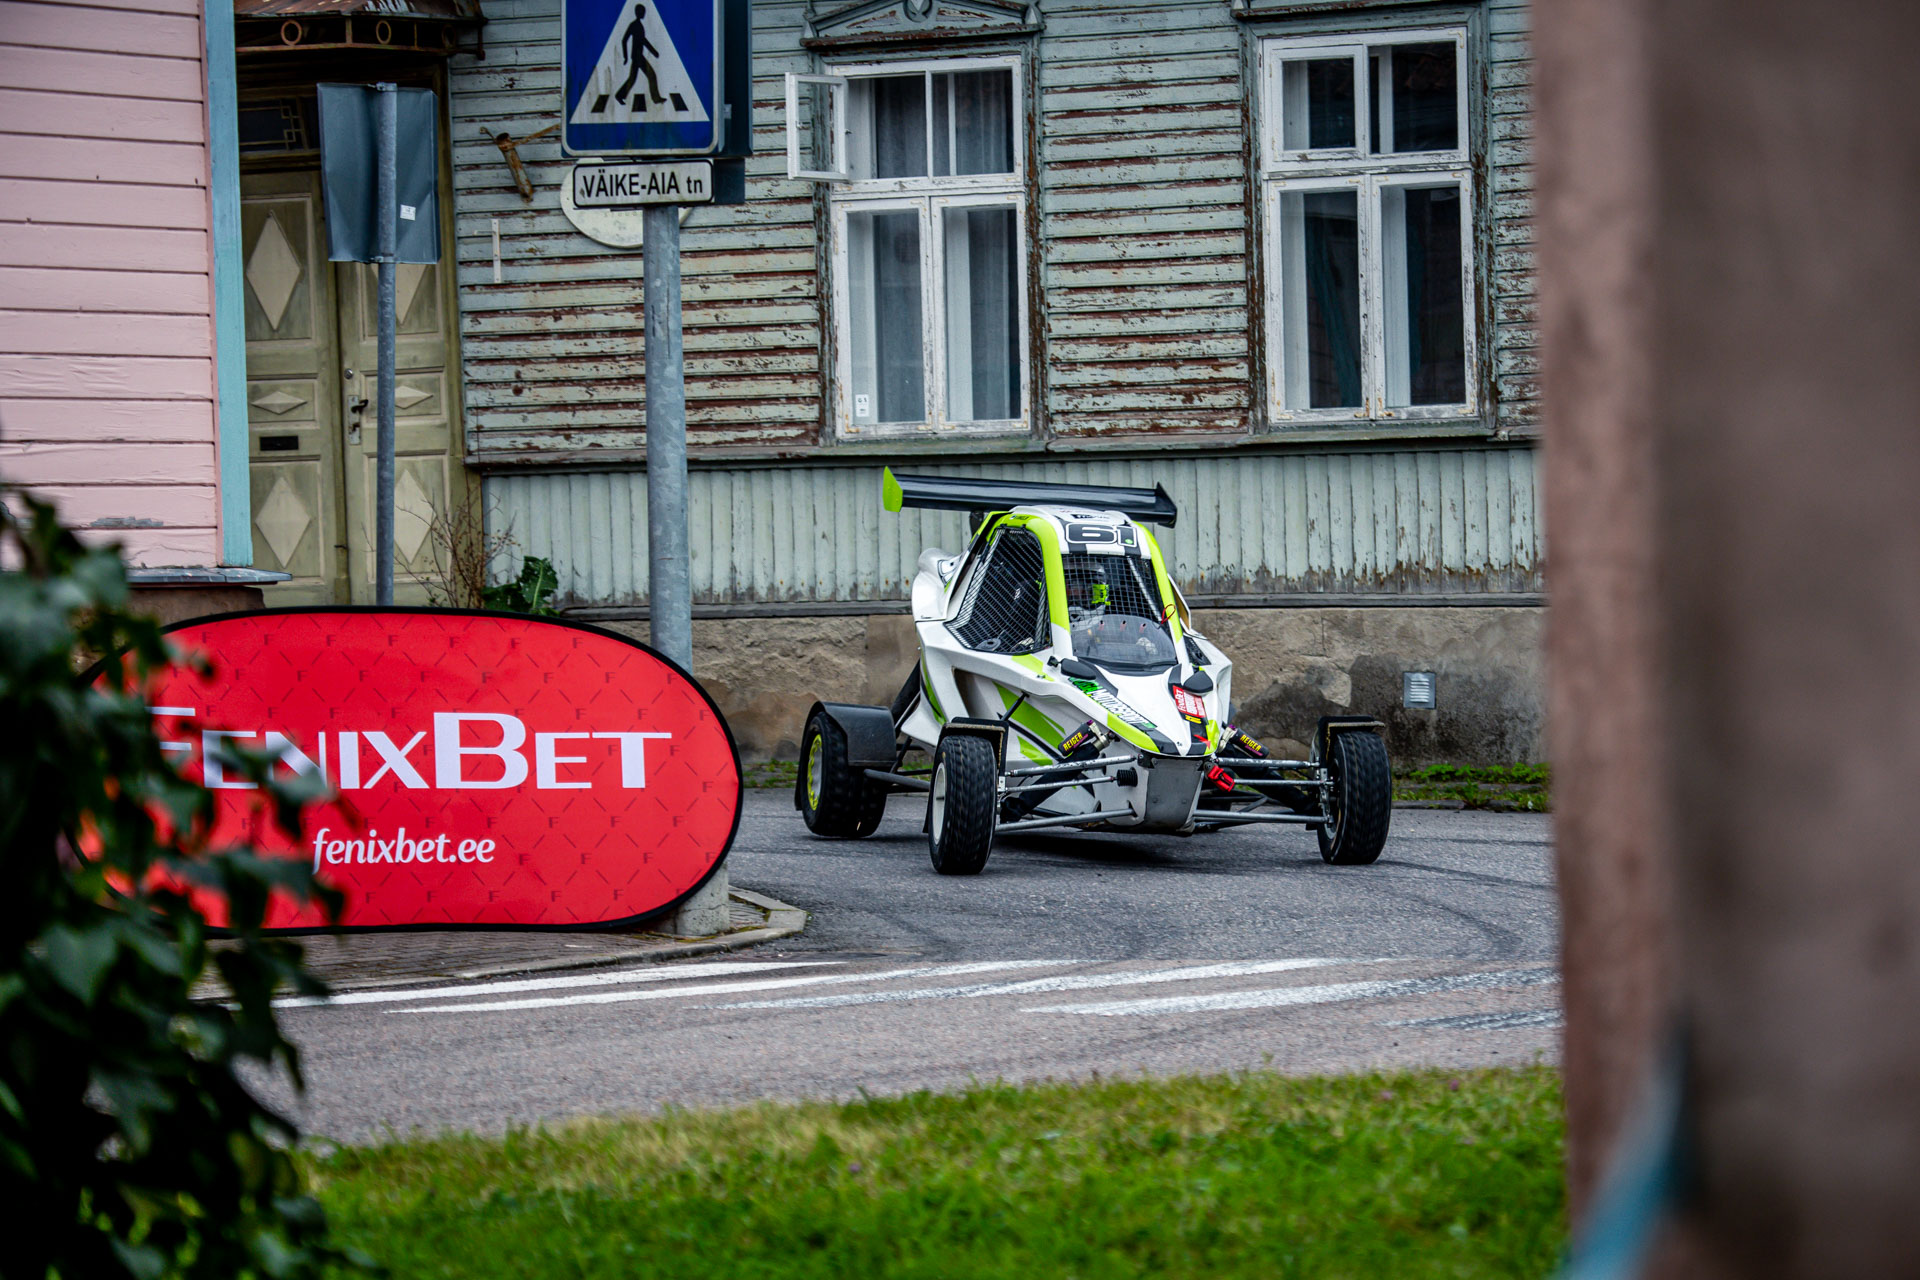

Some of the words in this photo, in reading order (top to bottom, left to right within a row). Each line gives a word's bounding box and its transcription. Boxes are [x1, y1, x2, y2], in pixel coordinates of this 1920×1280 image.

[582, 169, 680, 198] VÄIKE-AIA
[686, 176, 703, 194] tn
[1063, 732, 1083, 751] REIGER
[1240, 734, 1262, 751] REIGER
[312, 827, 496, 875] fenixbet.ee
